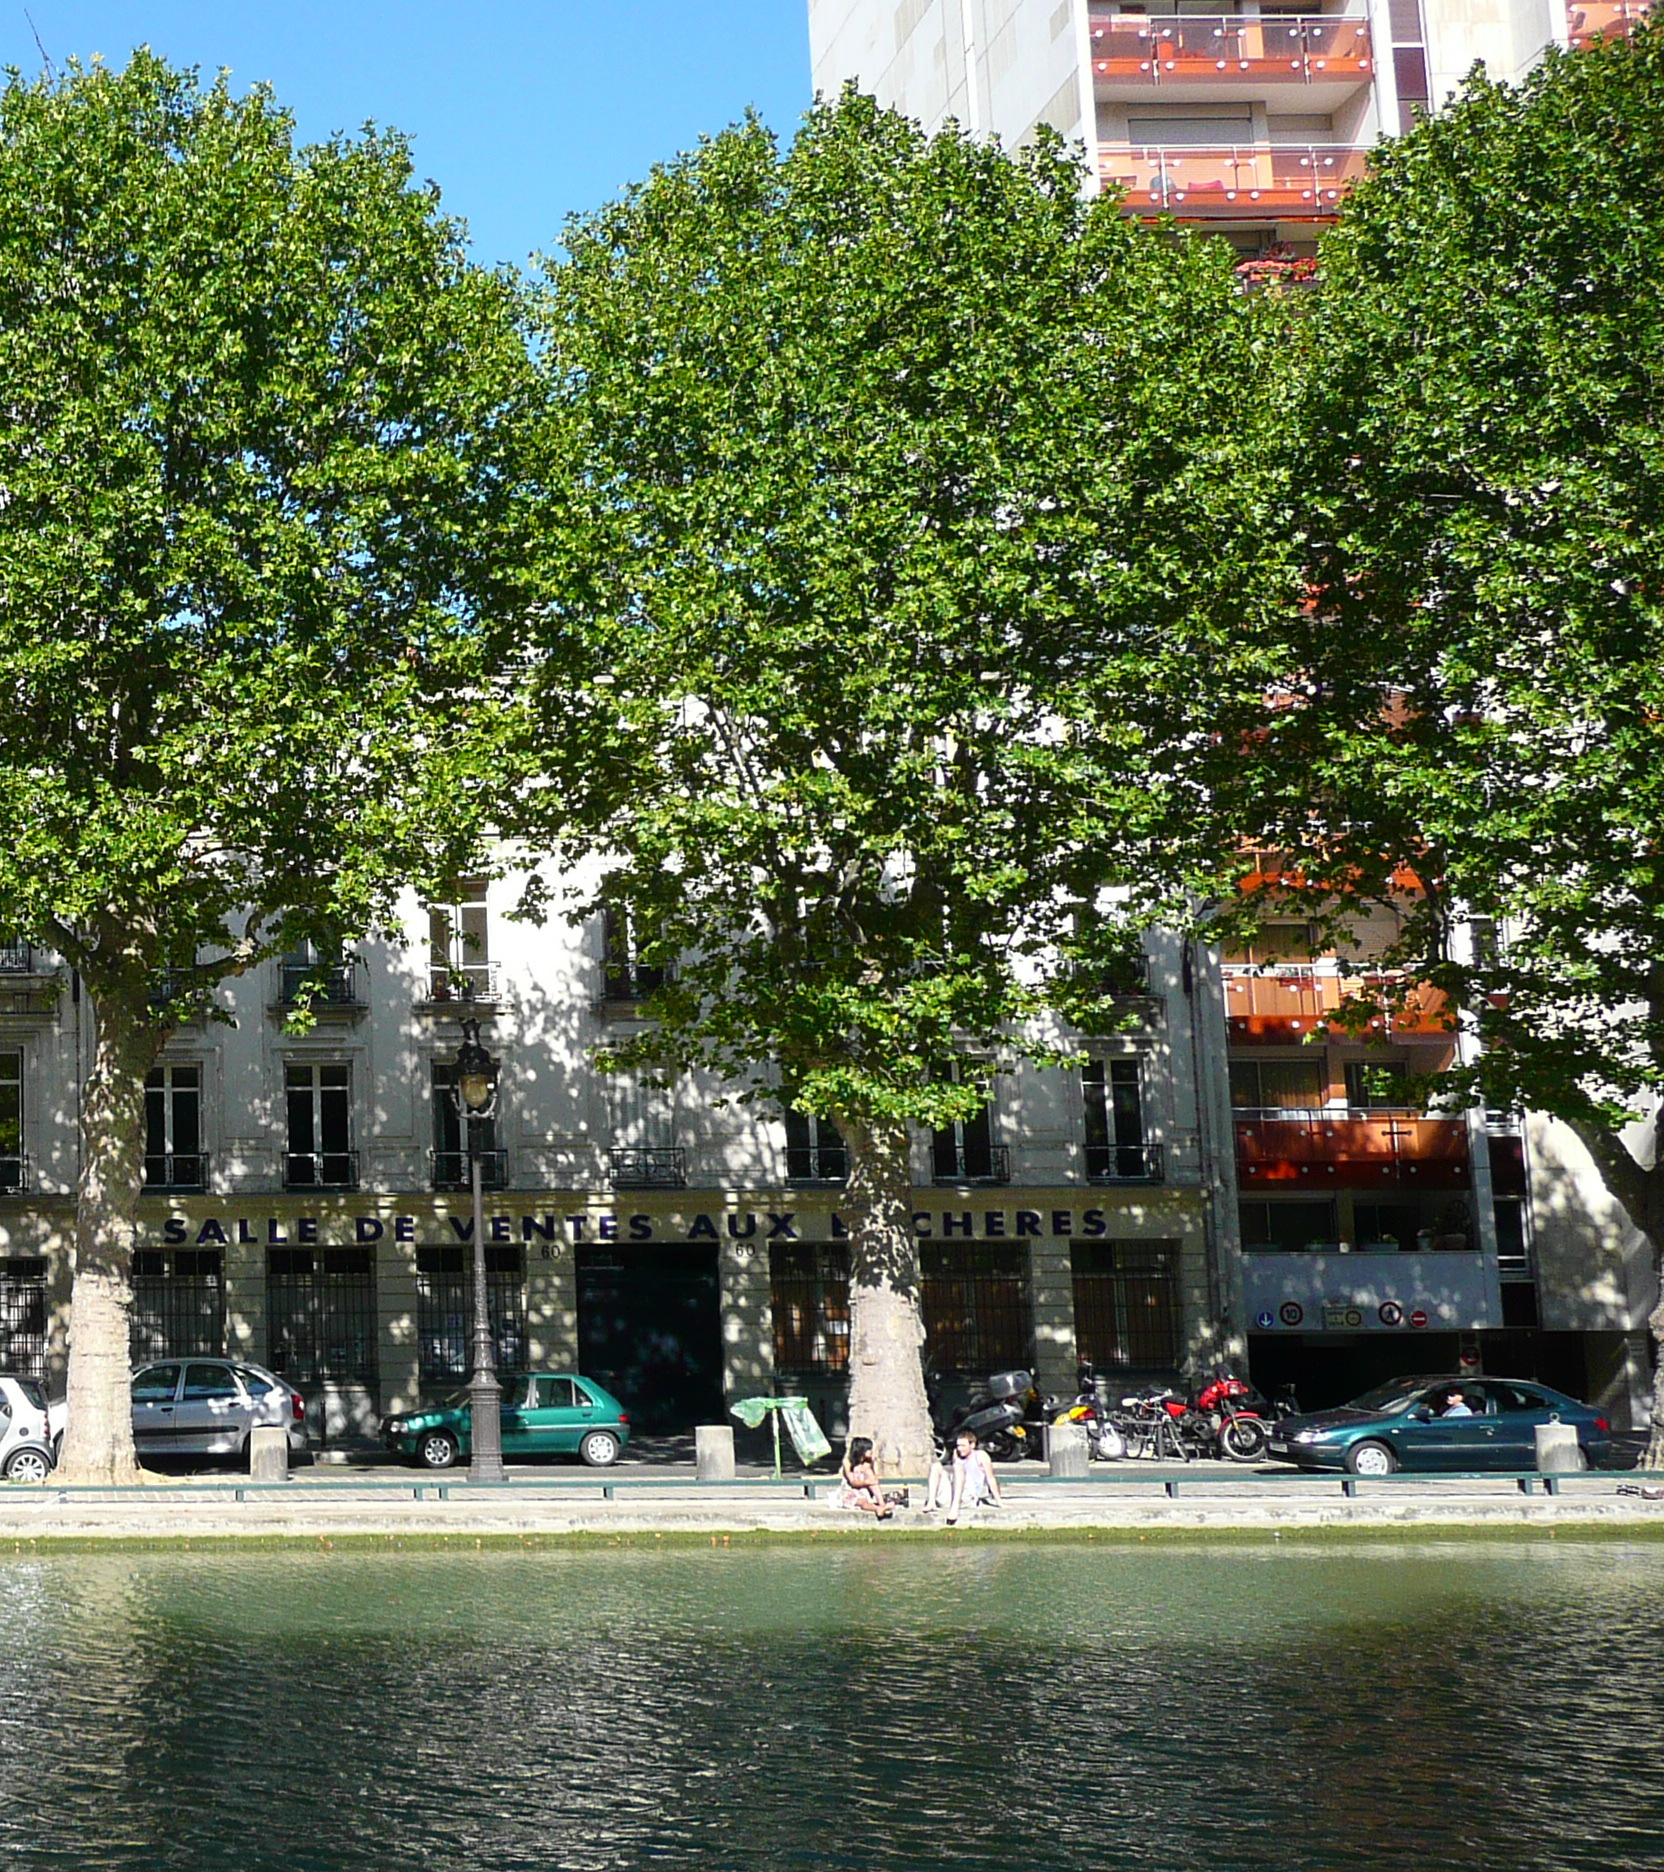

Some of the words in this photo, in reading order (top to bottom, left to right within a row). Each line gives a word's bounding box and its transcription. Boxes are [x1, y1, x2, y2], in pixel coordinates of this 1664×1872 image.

[164, 1218, 317, 1244] SALLE
[356, 1217, 414, 1243] DE
[448, 1215, 653, 1241] VENTES
[688, 1213, 798, 1239] AUX
[831, 1210, 1107, 1238] ECHERES
[541, 1245, 561, 1260] 60
[736, 1243, 755, 1258] 60
[1286, 1308, 1298, 1320] 10
